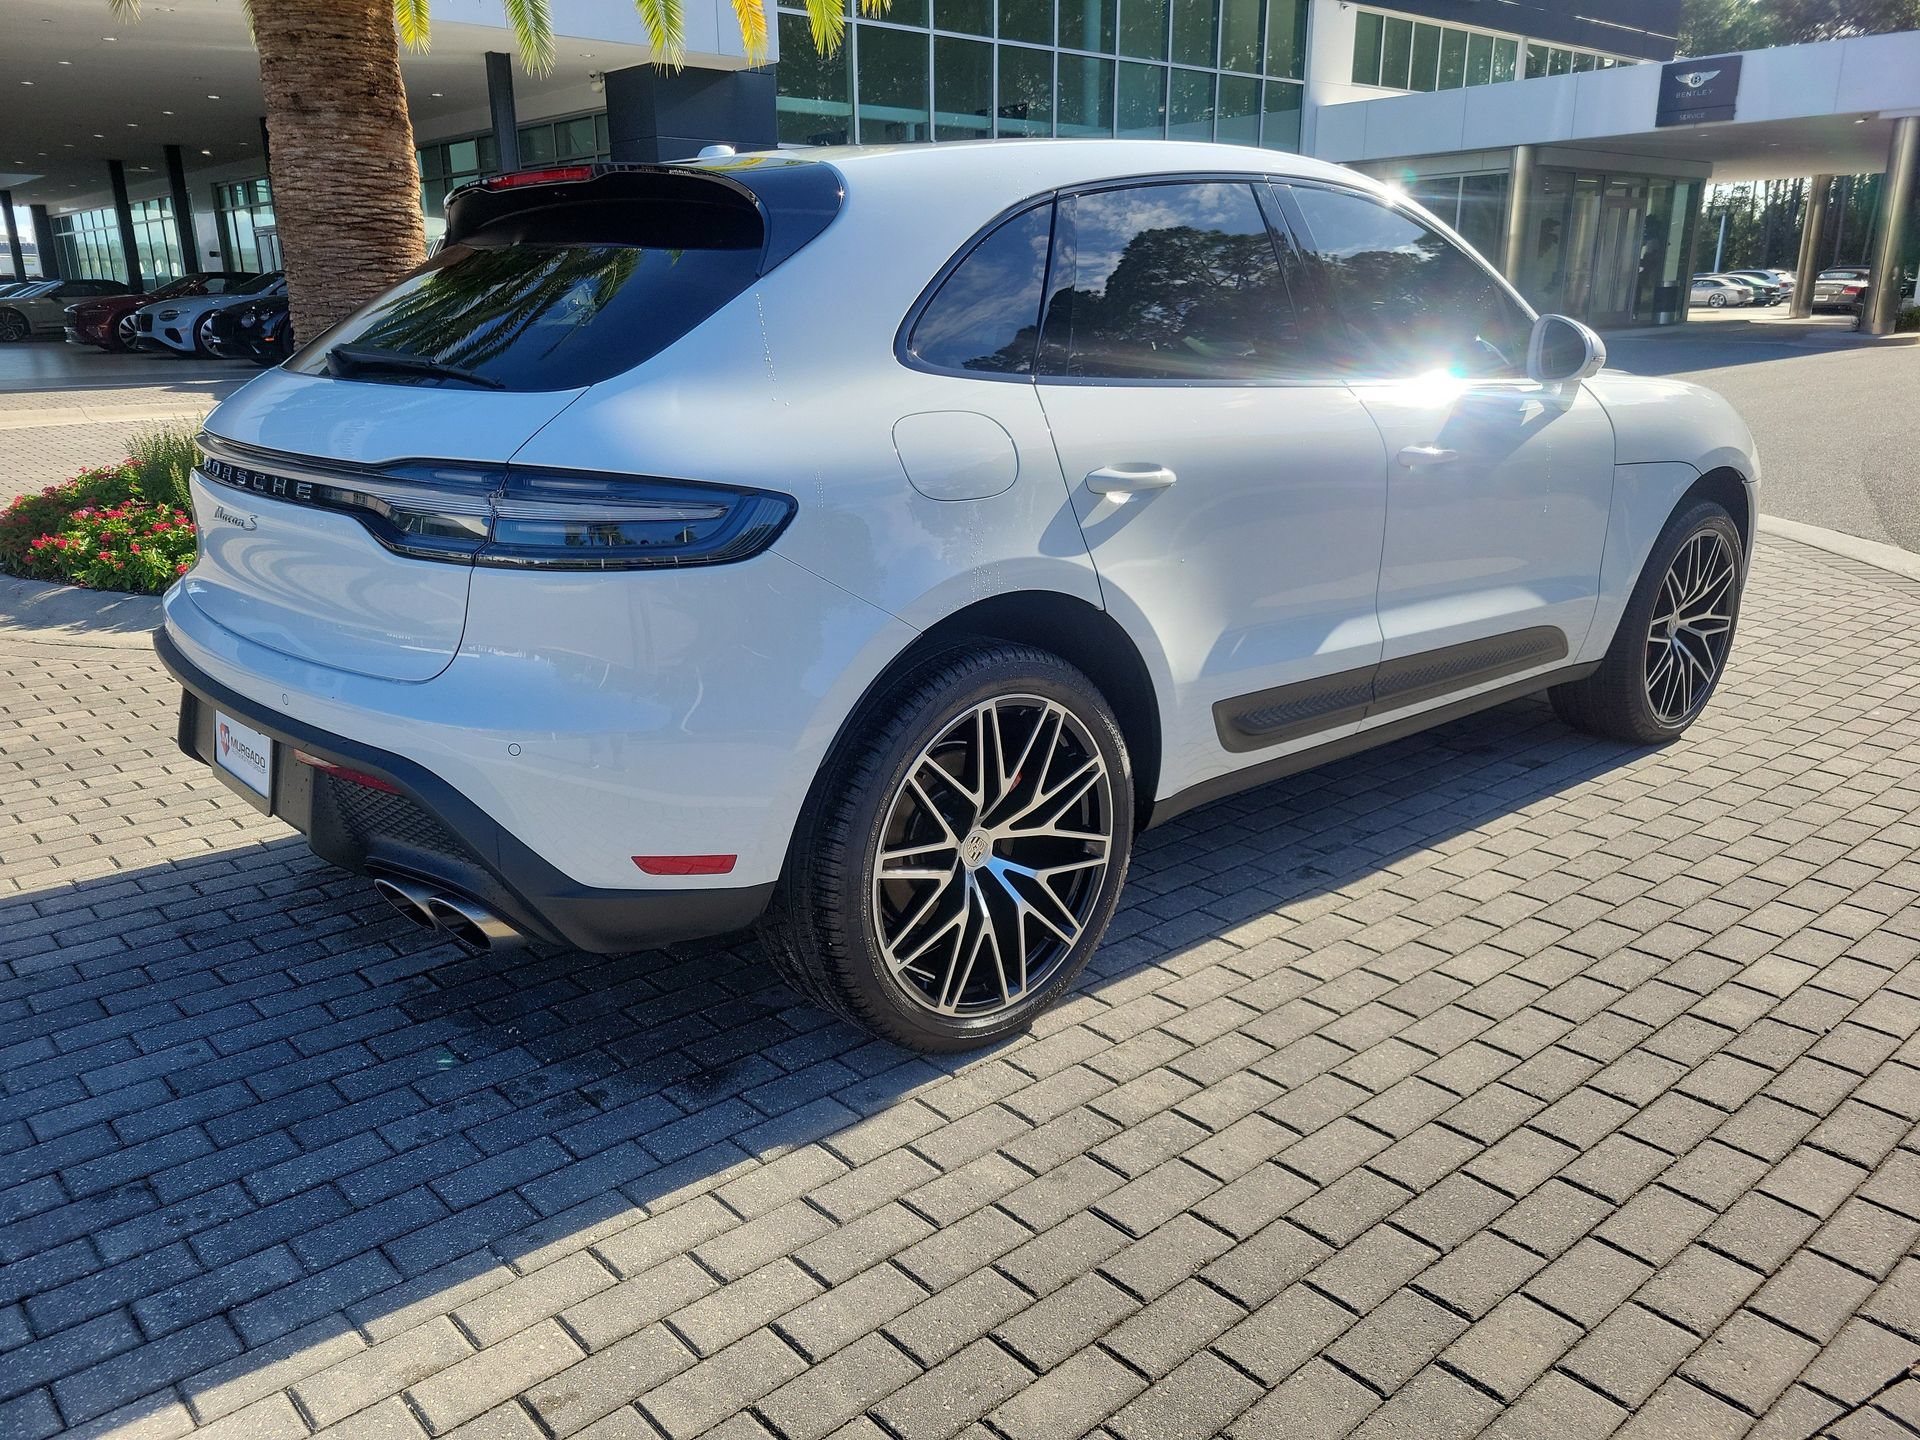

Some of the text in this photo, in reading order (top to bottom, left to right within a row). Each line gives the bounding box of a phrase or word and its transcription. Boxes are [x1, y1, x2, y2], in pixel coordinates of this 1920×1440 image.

[1676, 89, 1713, 98] BENTLEY
[1680, 112, 1705, 120] SERVICE
[203, 457, 312, 499] PORSCHE
[214, 505, 259, 532] Macan S
[231, 736, 265, 768] MURGADO
